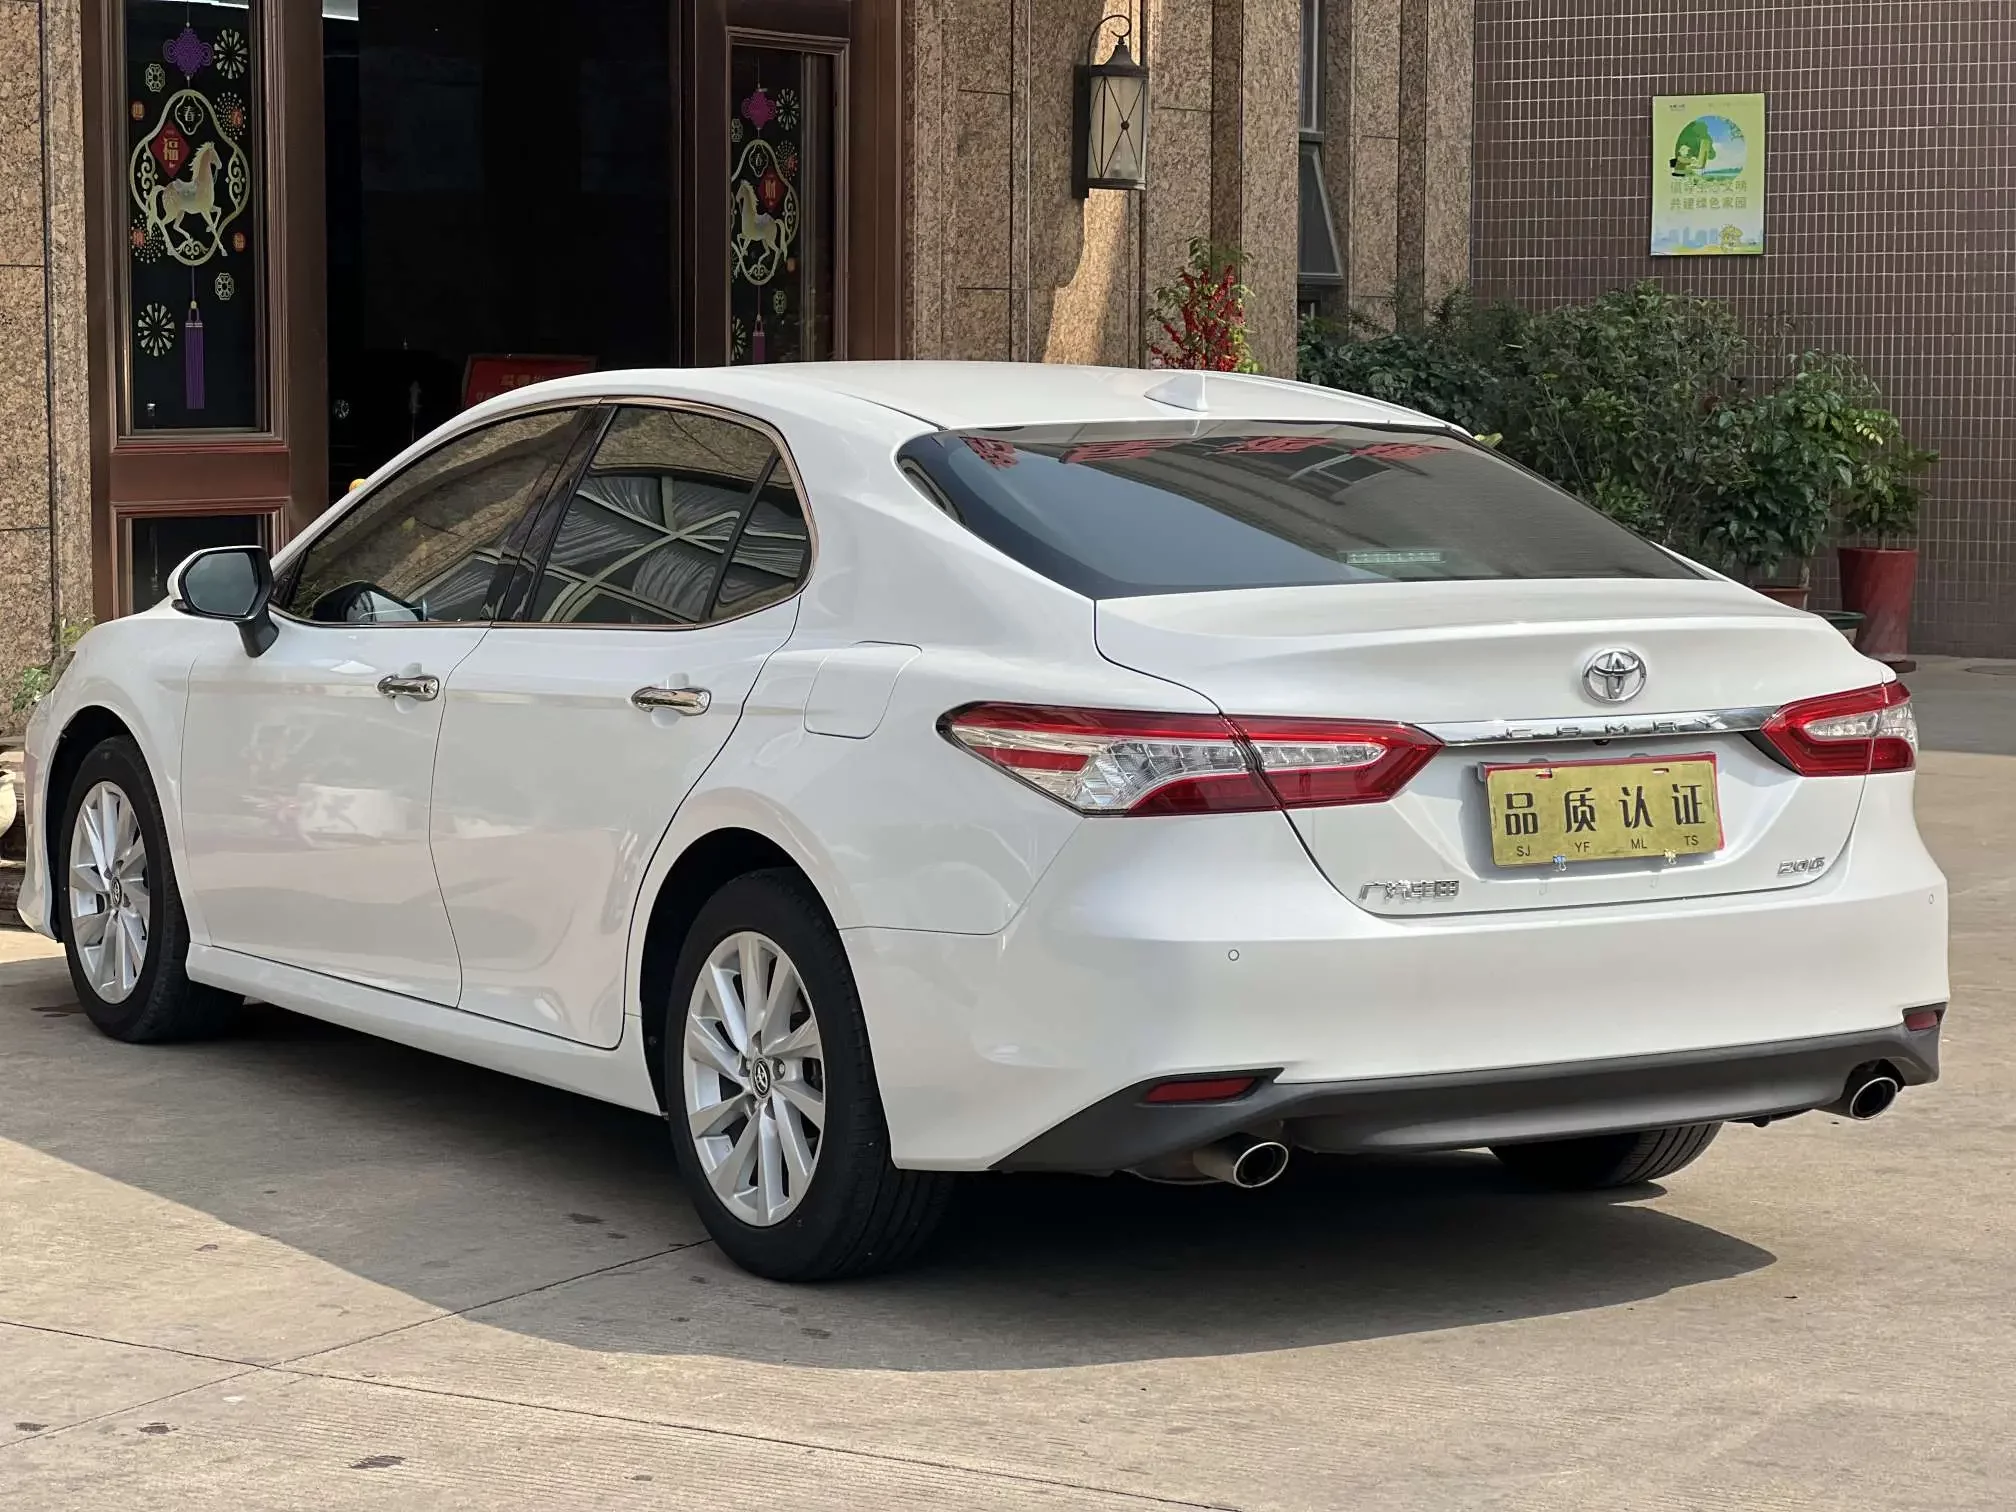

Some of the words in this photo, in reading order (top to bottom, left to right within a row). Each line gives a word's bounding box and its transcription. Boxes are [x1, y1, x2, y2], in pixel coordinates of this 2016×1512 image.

[184, 105, 195, 122] 春
[162, 137, 180, 161] 福
[1670, 197, 1748, 212] 共建绿色家园
[1505, 783, 1706, 836] 品质认证
[1516, 846, 1531, 857] SJ
[1574, 841, 1592, 853] YF
[1631, 837, 1648, 850] ML
[1683, 834, 1699, 846] TS
[1358, 879, 1460, 901] 广汽丰田
